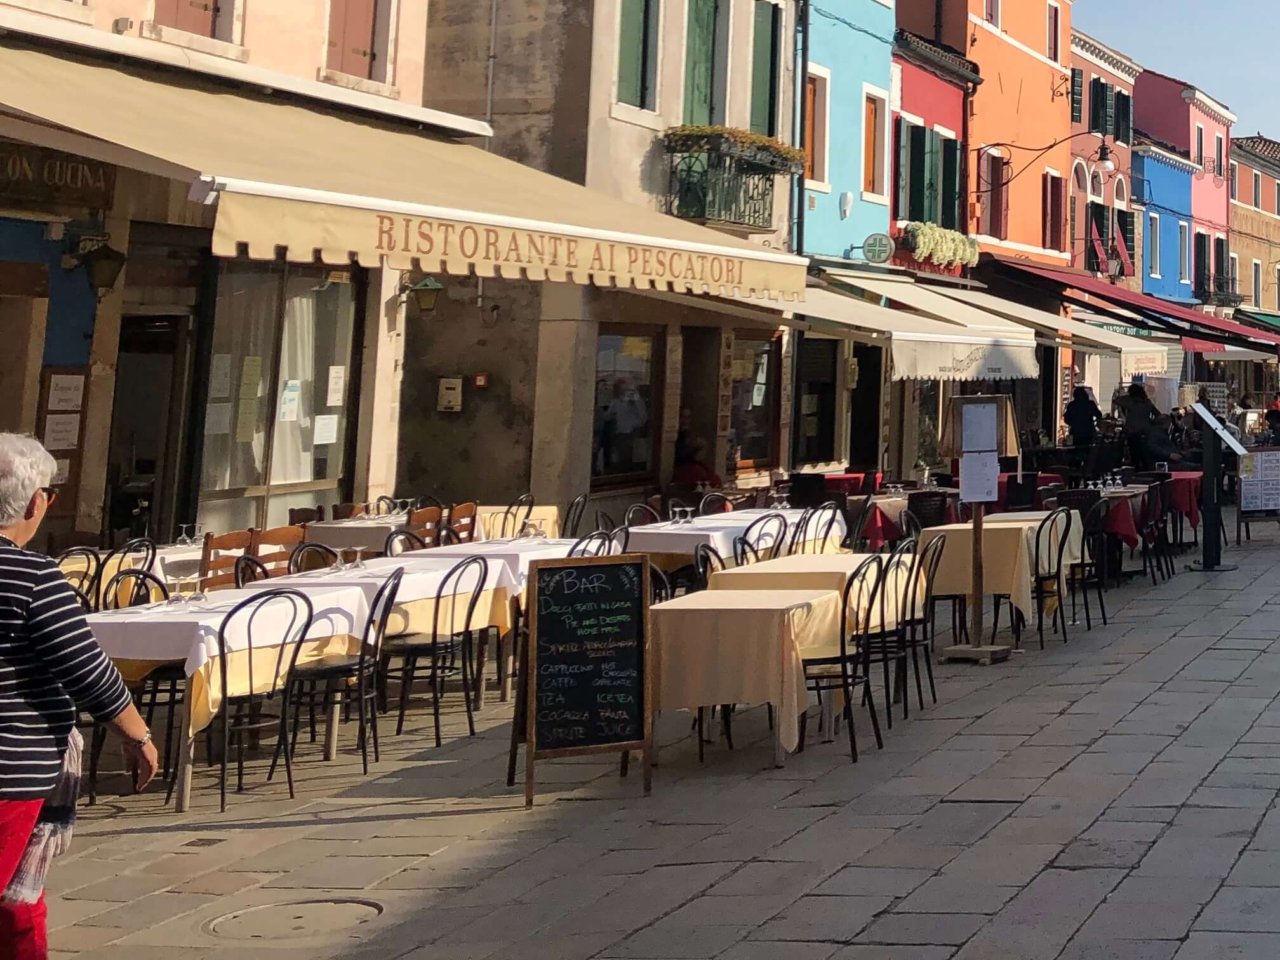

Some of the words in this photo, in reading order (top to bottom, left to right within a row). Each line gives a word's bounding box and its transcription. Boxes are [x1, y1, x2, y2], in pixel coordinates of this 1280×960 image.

[43, 159, 106, 192] CUCINA
[375, 214, 578, 268] RISTORANTE
[588, 243, 616, 272] AI
[626, 246, 745, 286] PESCATORI
[560, 569, 612, 594] BAR
[538, 692, 566, 706] TEA
[596, 722, 632, 737] JUICE
